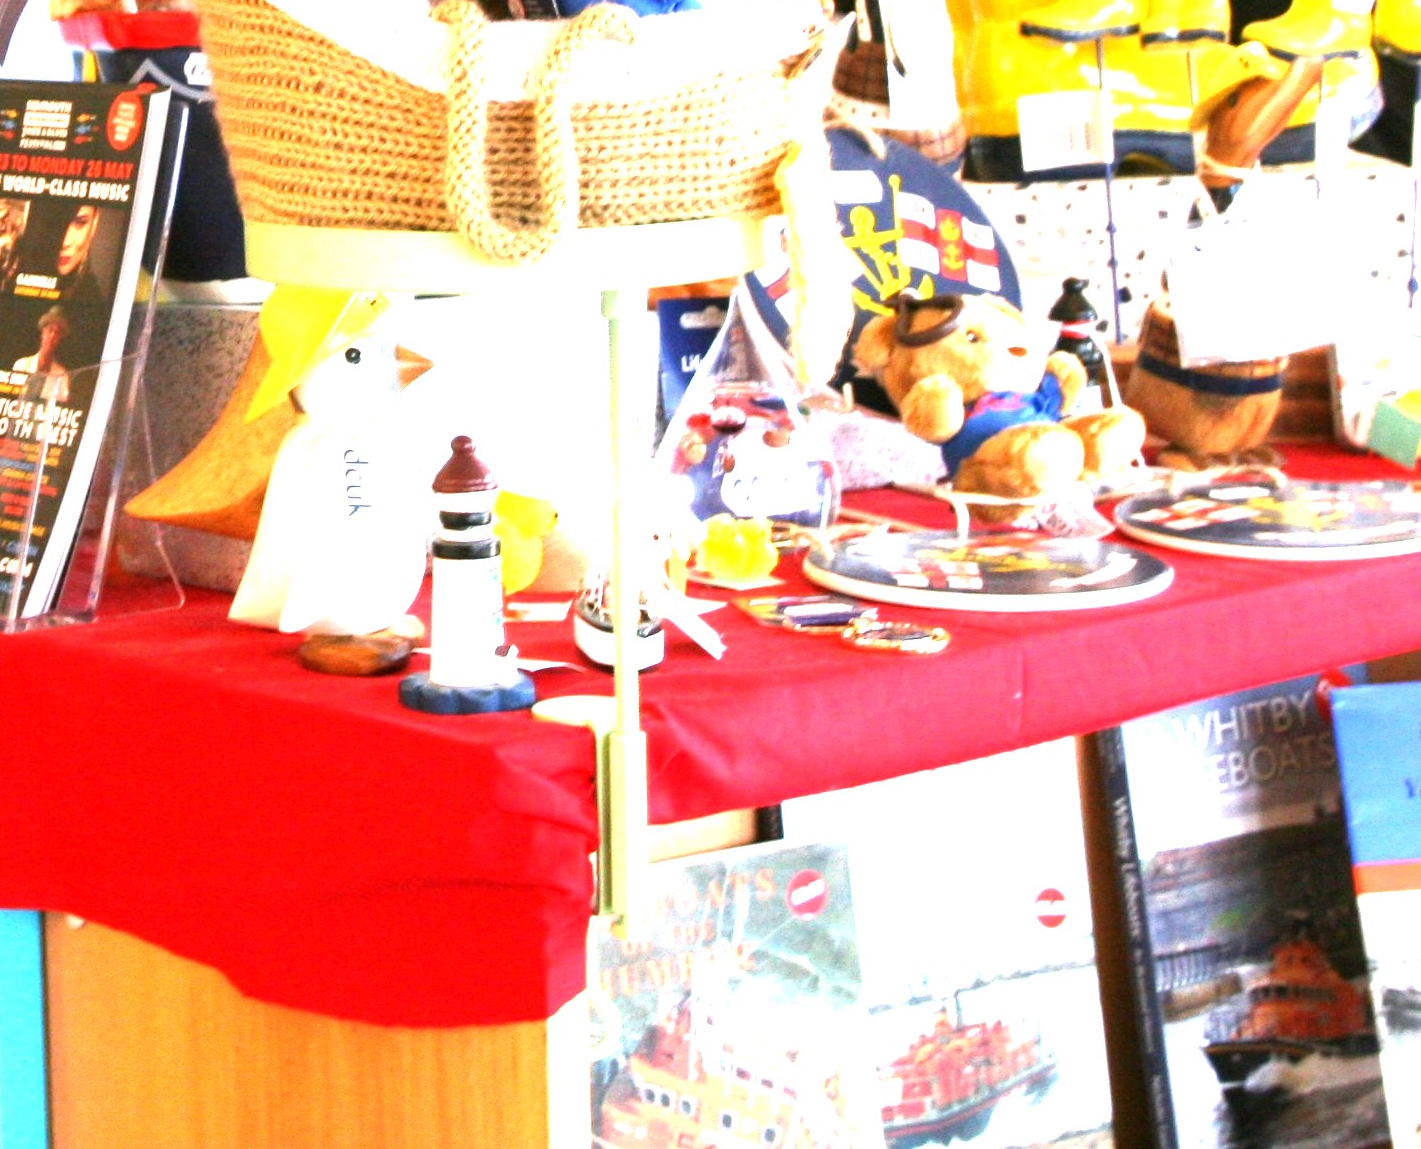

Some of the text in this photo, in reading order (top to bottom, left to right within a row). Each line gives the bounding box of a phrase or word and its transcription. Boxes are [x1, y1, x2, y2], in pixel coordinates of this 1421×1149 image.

[11, 154, 28, 172] TO
[29, 155, 85, 177] MONDAY
[103, 161, 135, 180] MAY
[2, 174, 88, 198] WORLD-CLASS
[88, 180, 131, 202] MUSIC
[1172, 690, 1314, 748] WHITBY
